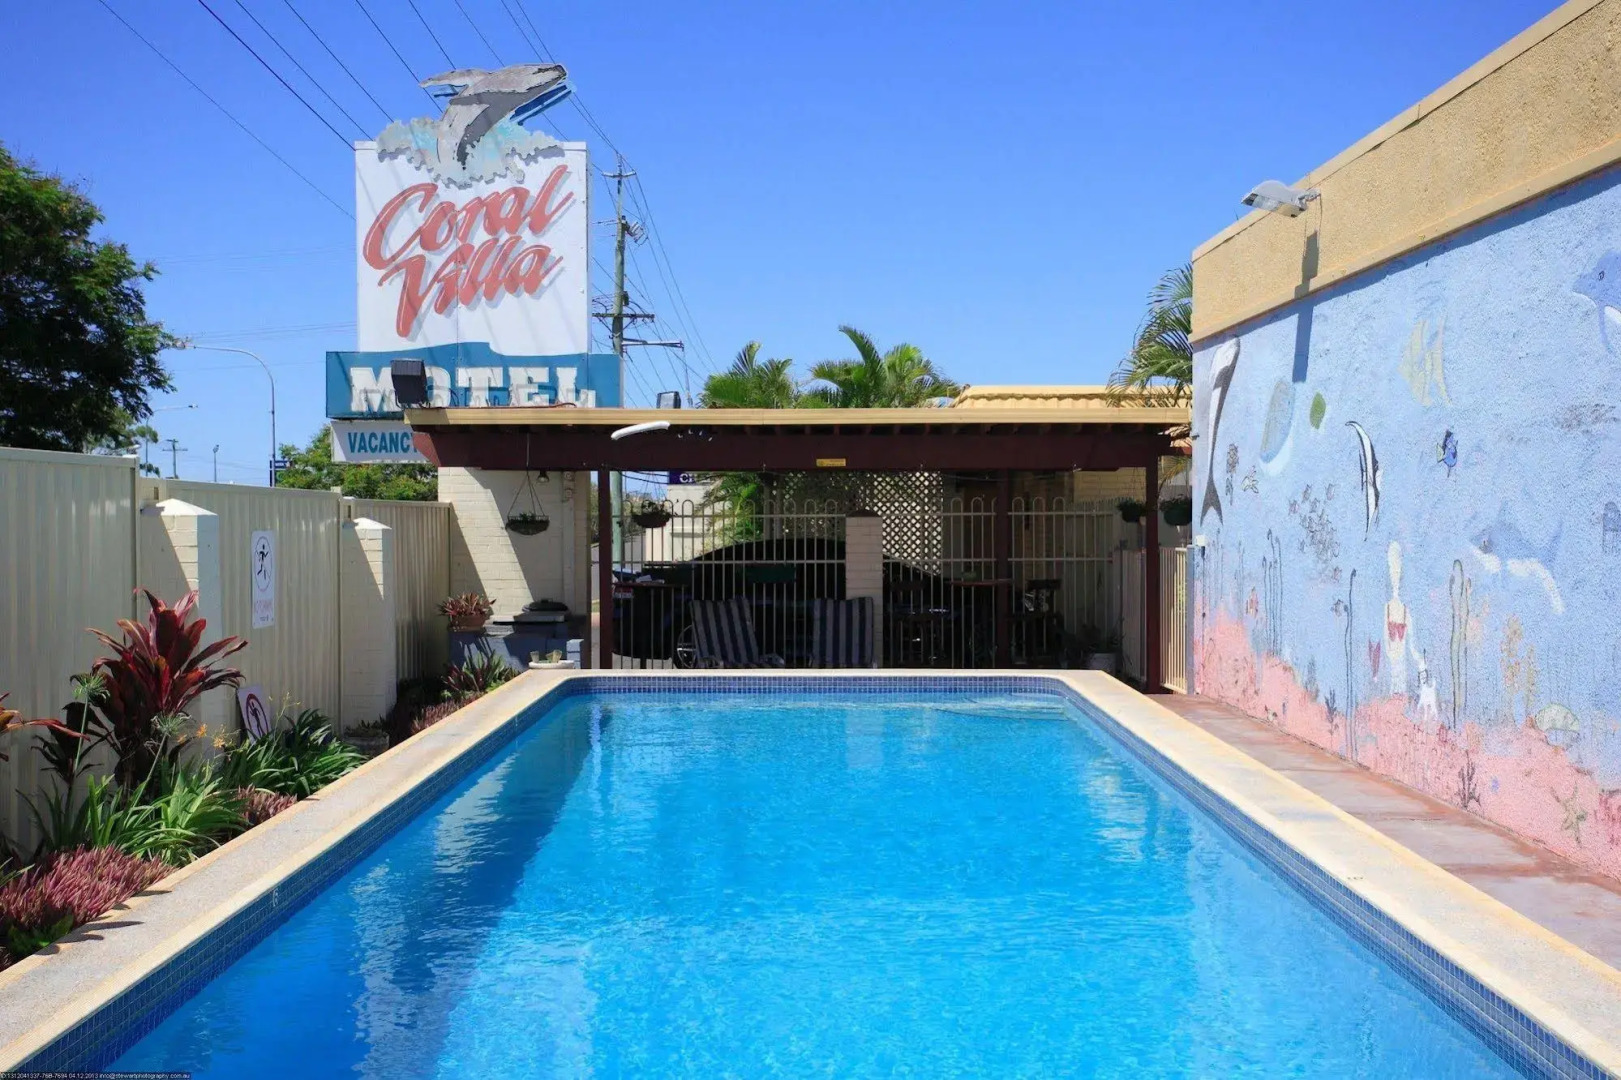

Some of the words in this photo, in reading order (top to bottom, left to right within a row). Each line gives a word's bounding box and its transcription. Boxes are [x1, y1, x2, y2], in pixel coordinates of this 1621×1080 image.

[363, 164, 574, 270] Coral
[378, 235, 564, 338] Villa
[350, 366, 596, 412] MOTEL
[347, 431, 418, 454] VACANC
